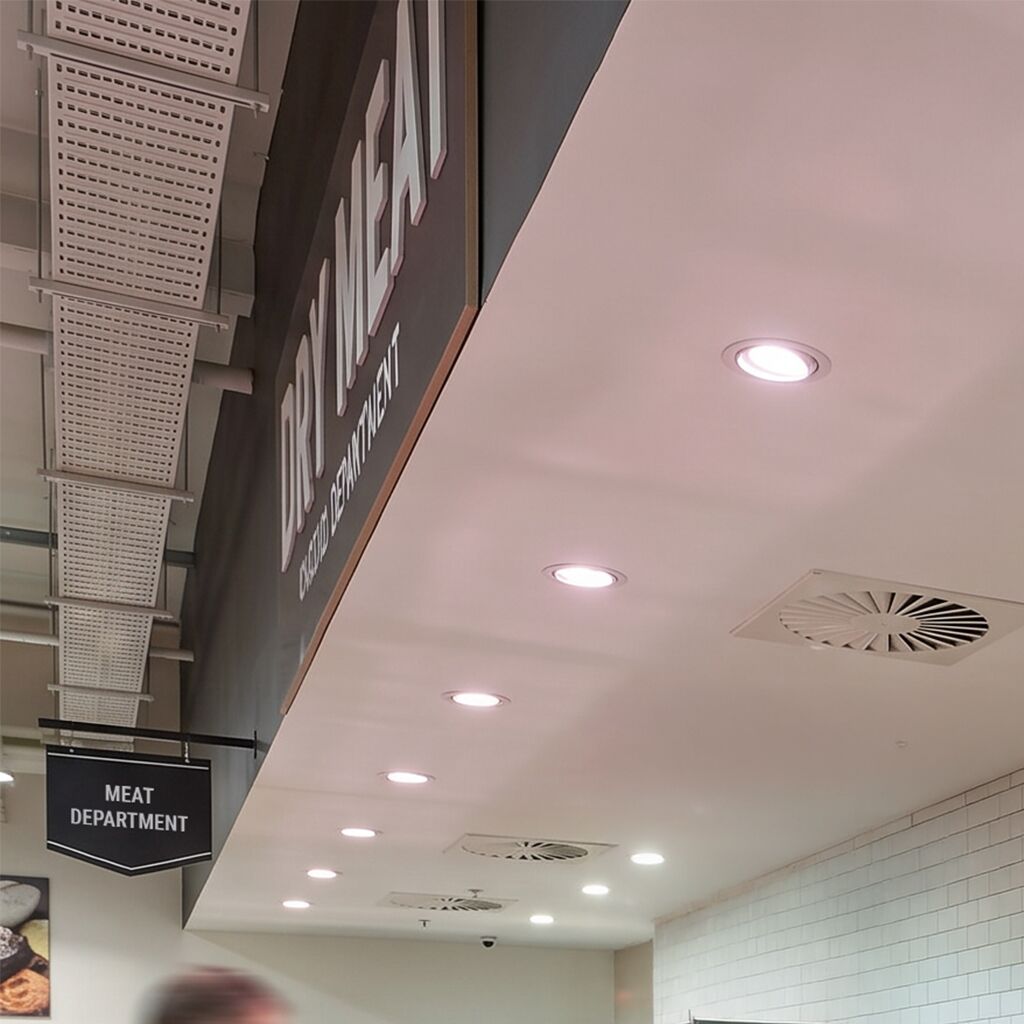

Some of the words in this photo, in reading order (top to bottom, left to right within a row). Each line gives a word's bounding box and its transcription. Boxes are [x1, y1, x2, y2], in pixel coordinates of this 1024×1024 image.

[281, 257, 330, 573] DRY
[105, 784, 154, 804] MEAT
[70, 807, 188, 832] DEPARTMENT
